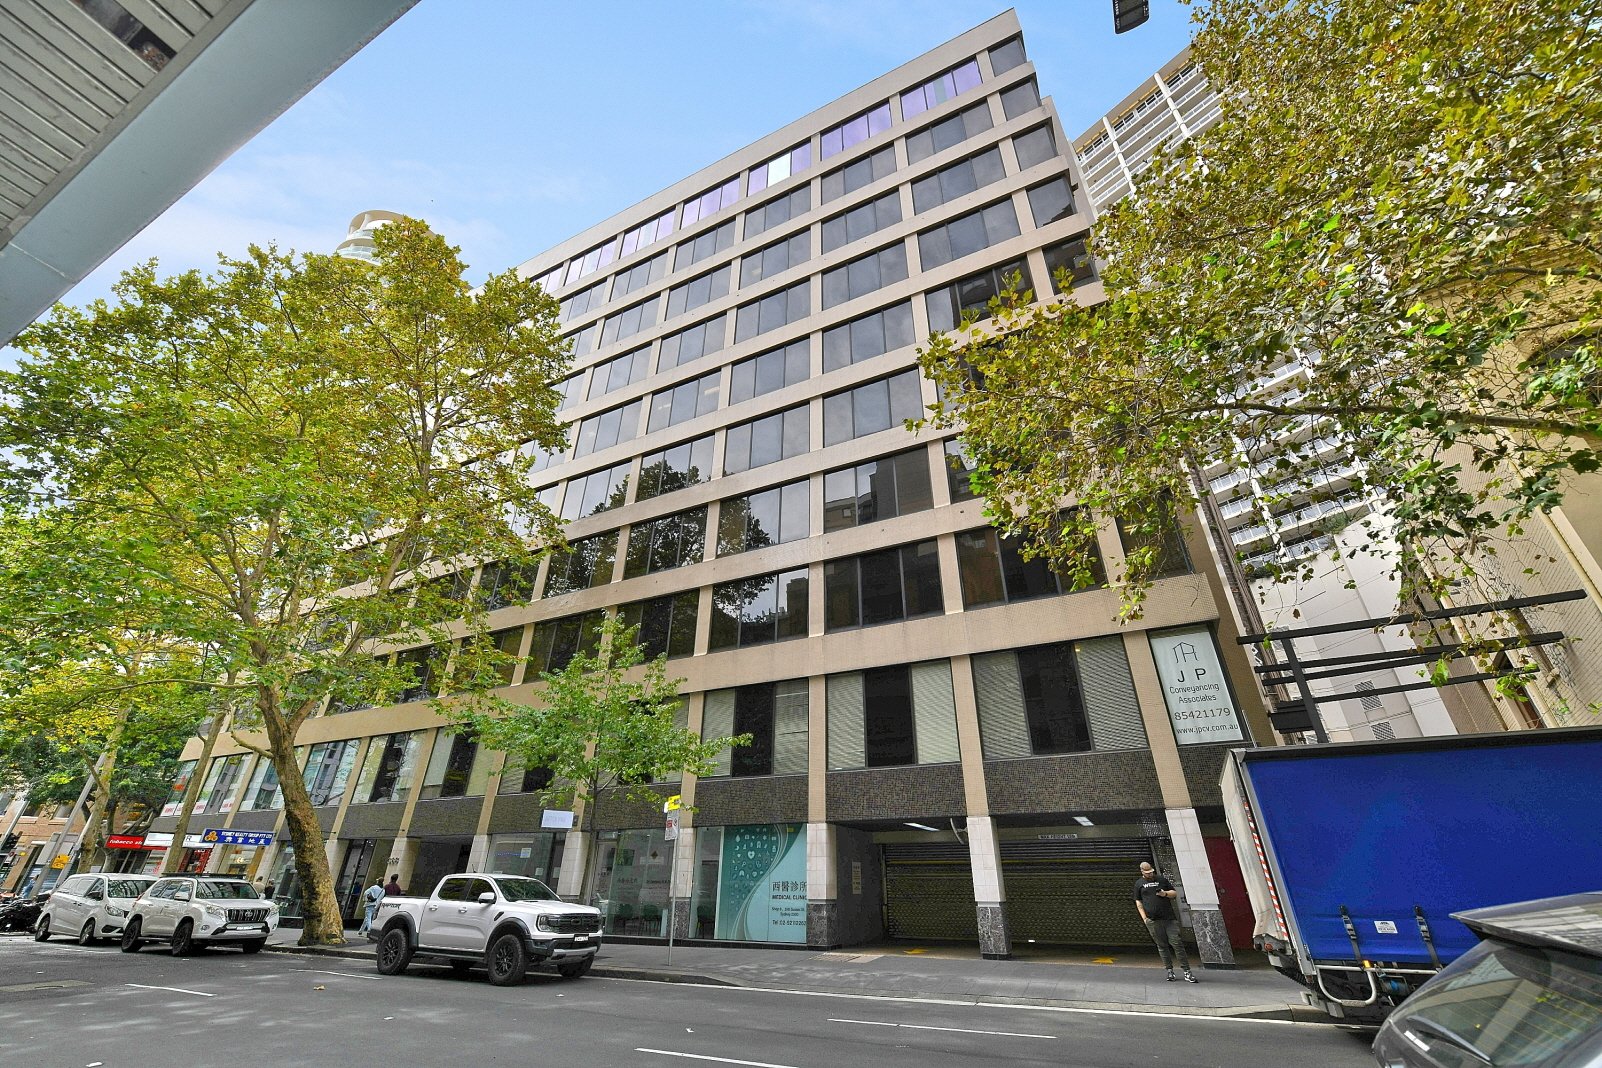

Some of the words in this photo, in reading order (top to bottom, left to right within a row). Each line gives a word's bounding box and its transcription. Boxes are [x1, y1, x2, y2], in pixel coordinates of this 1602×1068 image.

[1177, 670, 1185, 683] J
[1194, 668, 1207, 681] P
[1169, 683, 1219, 694] Conveyancing
[1179, 694, 1217, 703] Associates
[1174, 707, 1231, 721] 85421179
[1176, 723, 1239, 735] www.jpcv.com.au
